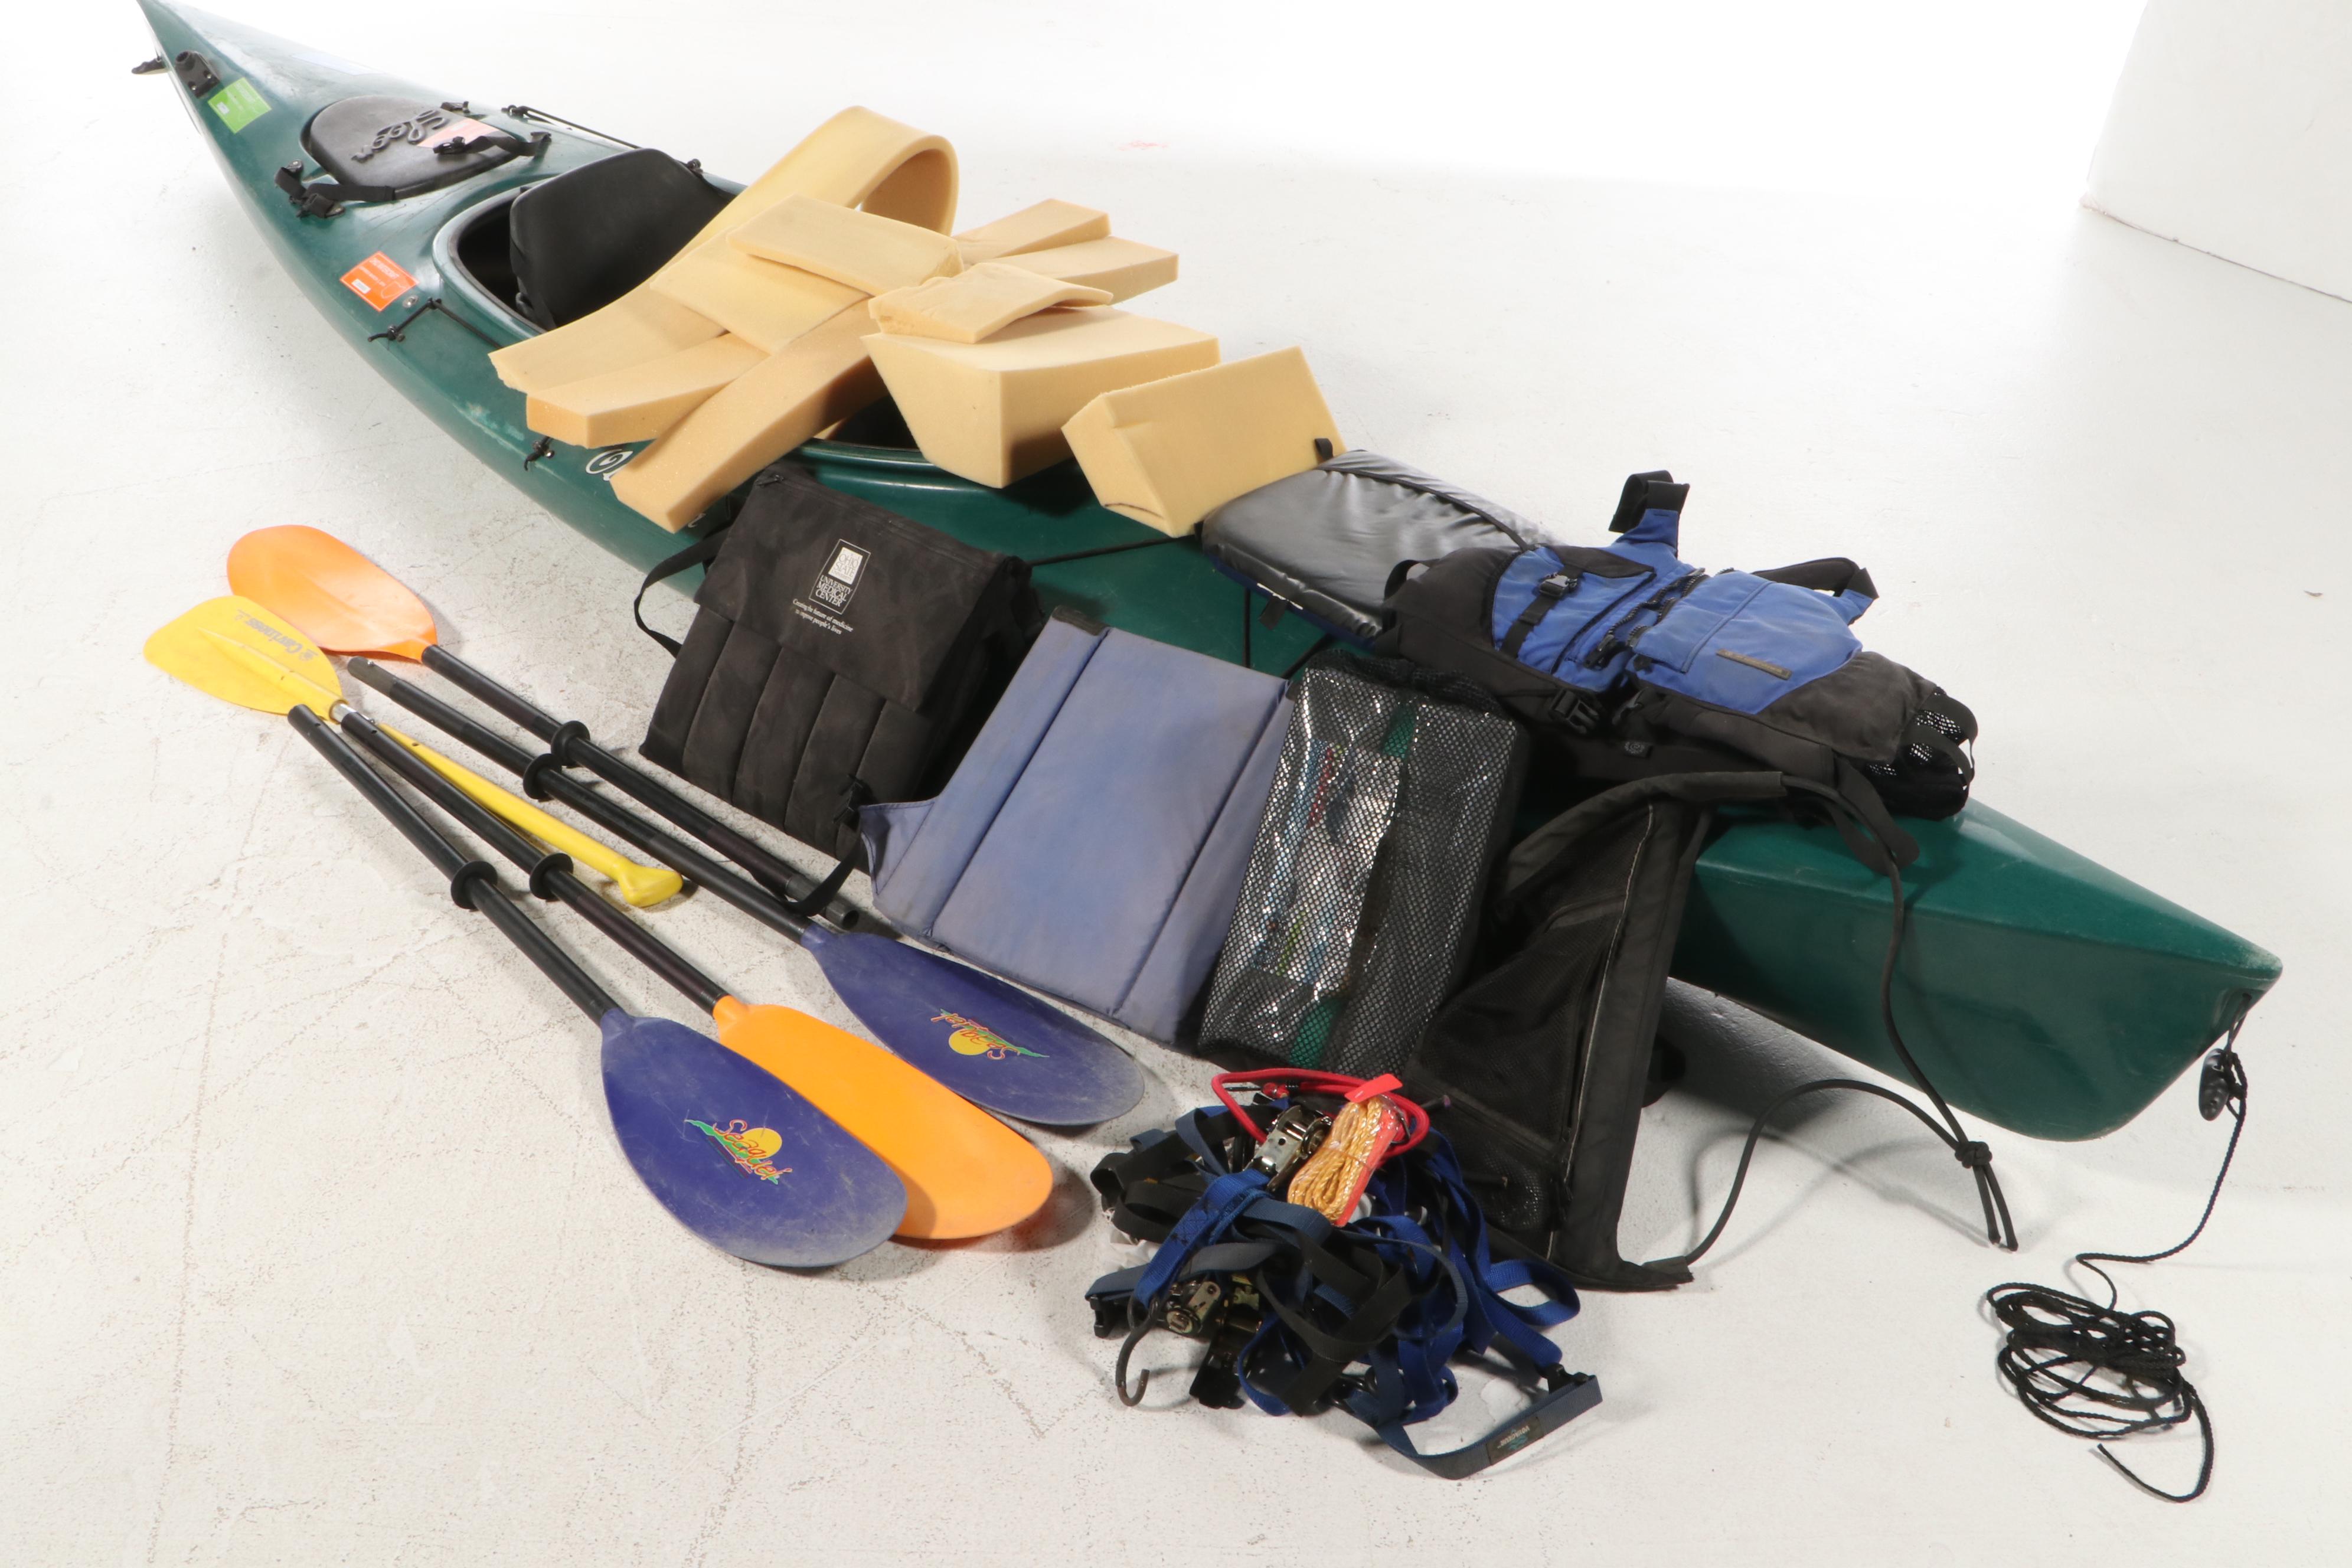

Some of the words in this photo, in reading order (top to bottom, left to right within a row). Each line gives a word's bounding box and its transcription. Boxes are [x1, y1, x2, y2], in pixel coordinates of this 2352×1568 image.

[835, 561, 857, 577] STATE
[839, 553, 860, 568] OHIO
[816, 580, 847, 602] MEDICAL
[820, 574, 852, 594] UNIVERSITY
[815, 589, 843, 607] CENTER
[793, 598, 808, 611] Creating
[813, 607, 827, 619] future
[832, 619, 854, 632] medicine
[812, 617, 831, 631] people's
[831, 624, 842, 635] lives
[930, 1013, 1020, 1060] Seaquel
[713, 1119, 793, 1180] Seaquel
